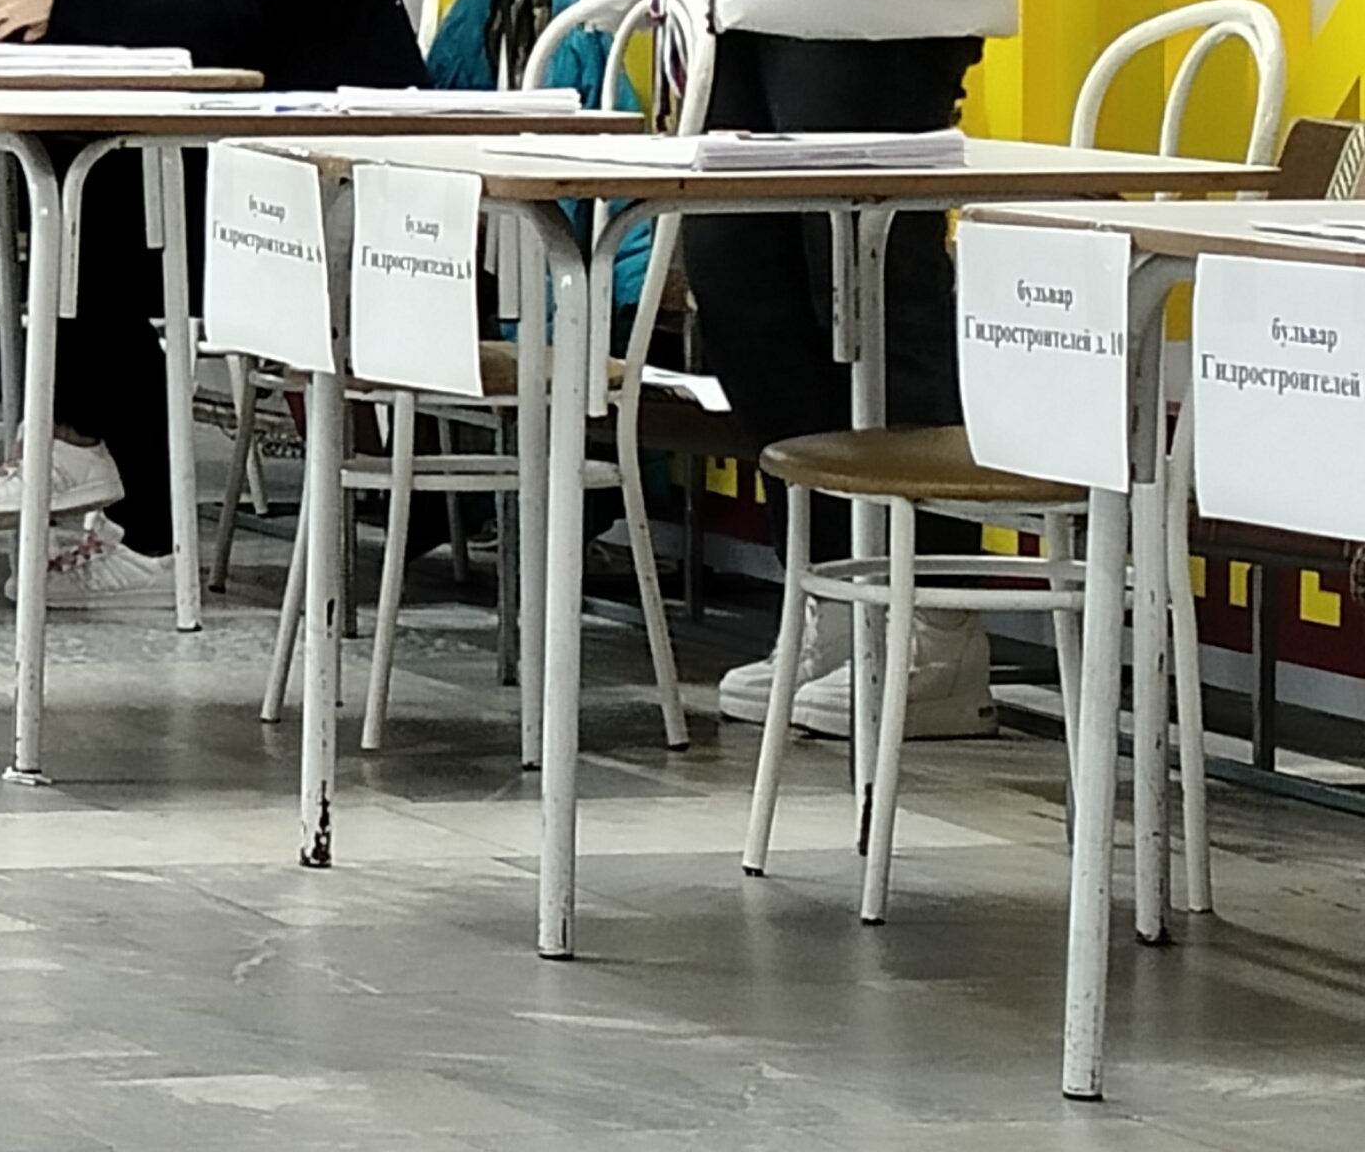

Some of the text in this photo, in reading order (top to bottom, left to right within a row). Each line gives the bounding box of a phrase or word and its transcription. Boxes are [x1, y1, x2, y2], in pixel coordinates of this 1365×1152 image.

[362, 245, 454, 278] Гидростроителей
[1017, 279, 1073, 312] бульвар
[964, 315, 1092, 352] Гидростроителей
[1271, 317, 1338, 353] бульвар
[1201, 354, 1361, 397] Гидростроителей
